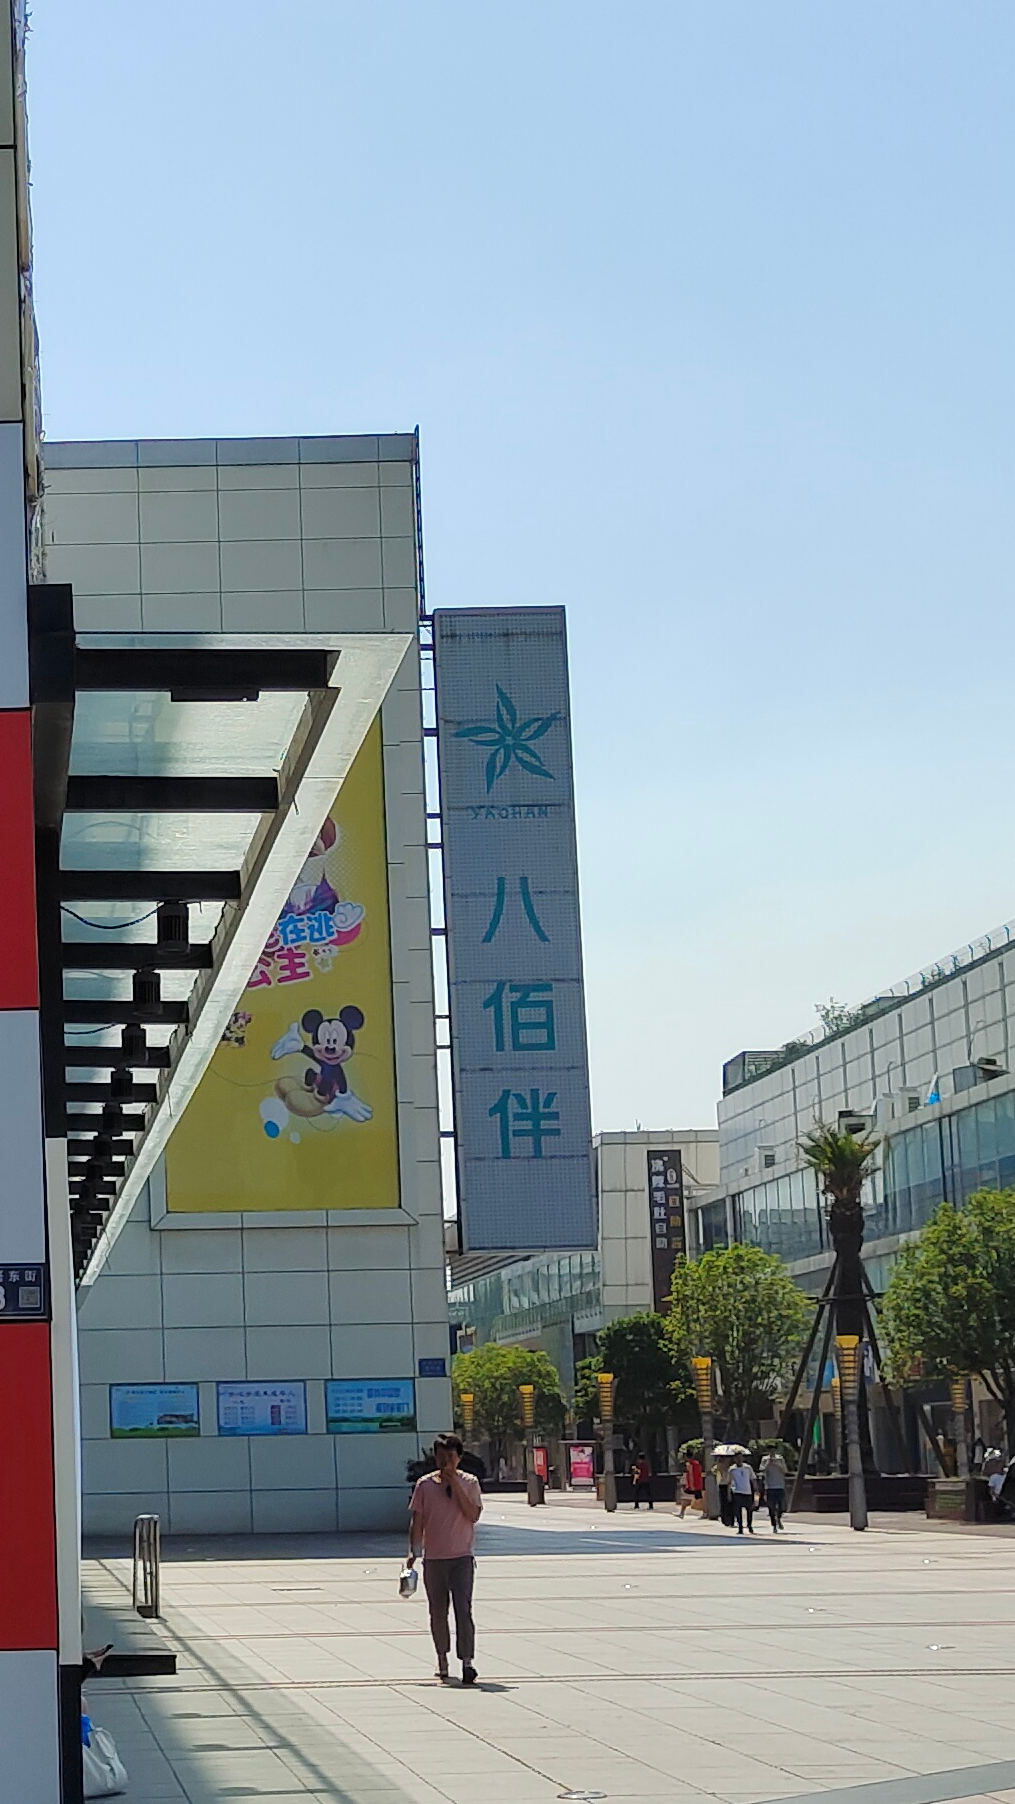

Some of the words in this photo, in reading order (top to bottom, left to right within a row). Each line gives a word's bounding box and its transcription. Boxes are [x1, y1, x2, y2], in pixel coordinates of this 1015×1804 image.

[468, 805, 549, 820] YAOHAN
[481, 877, 561, 1159] 八佰伴
[0, 1269, 37, 1283] 东街
